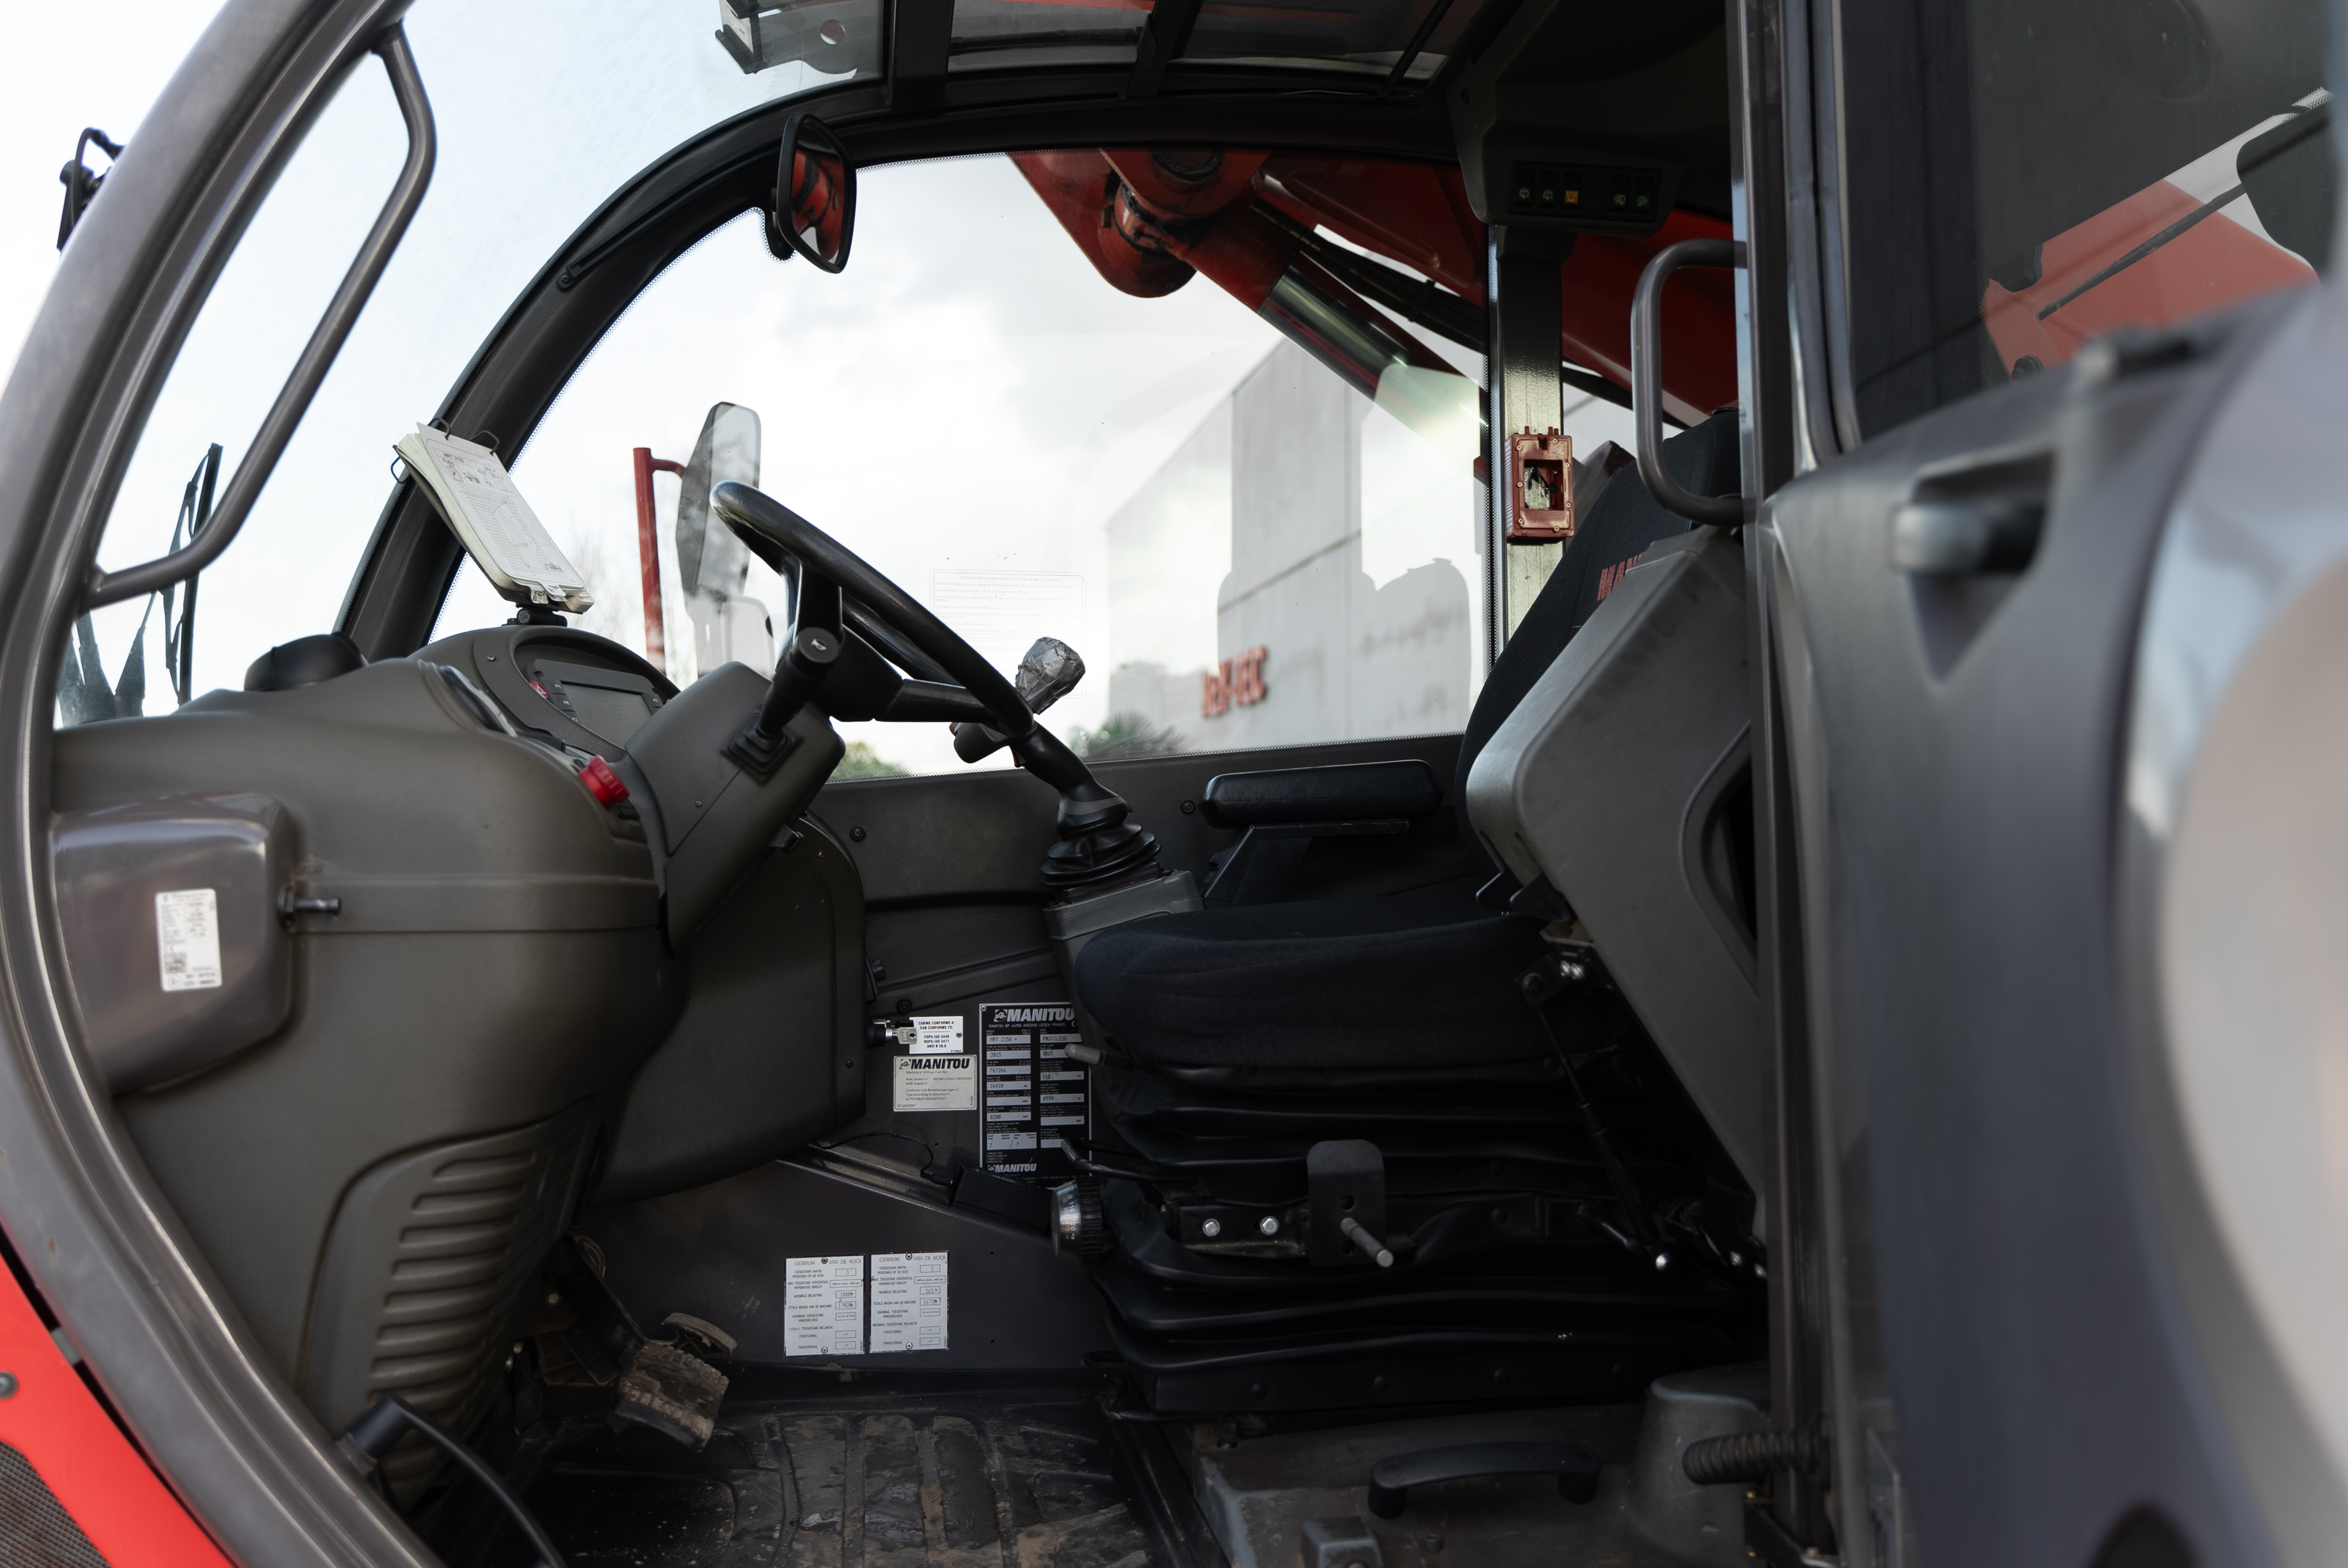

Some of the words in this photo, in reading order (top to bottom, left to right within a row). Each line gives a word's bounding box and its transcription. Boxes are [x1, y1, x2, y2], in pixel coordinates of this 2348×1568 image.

[1007, 1008, 1075, 1022] MANITOU
[911, 1058, 971, 1070] MANITOU
[995, 1163, 1037, 1173] MANITOU
